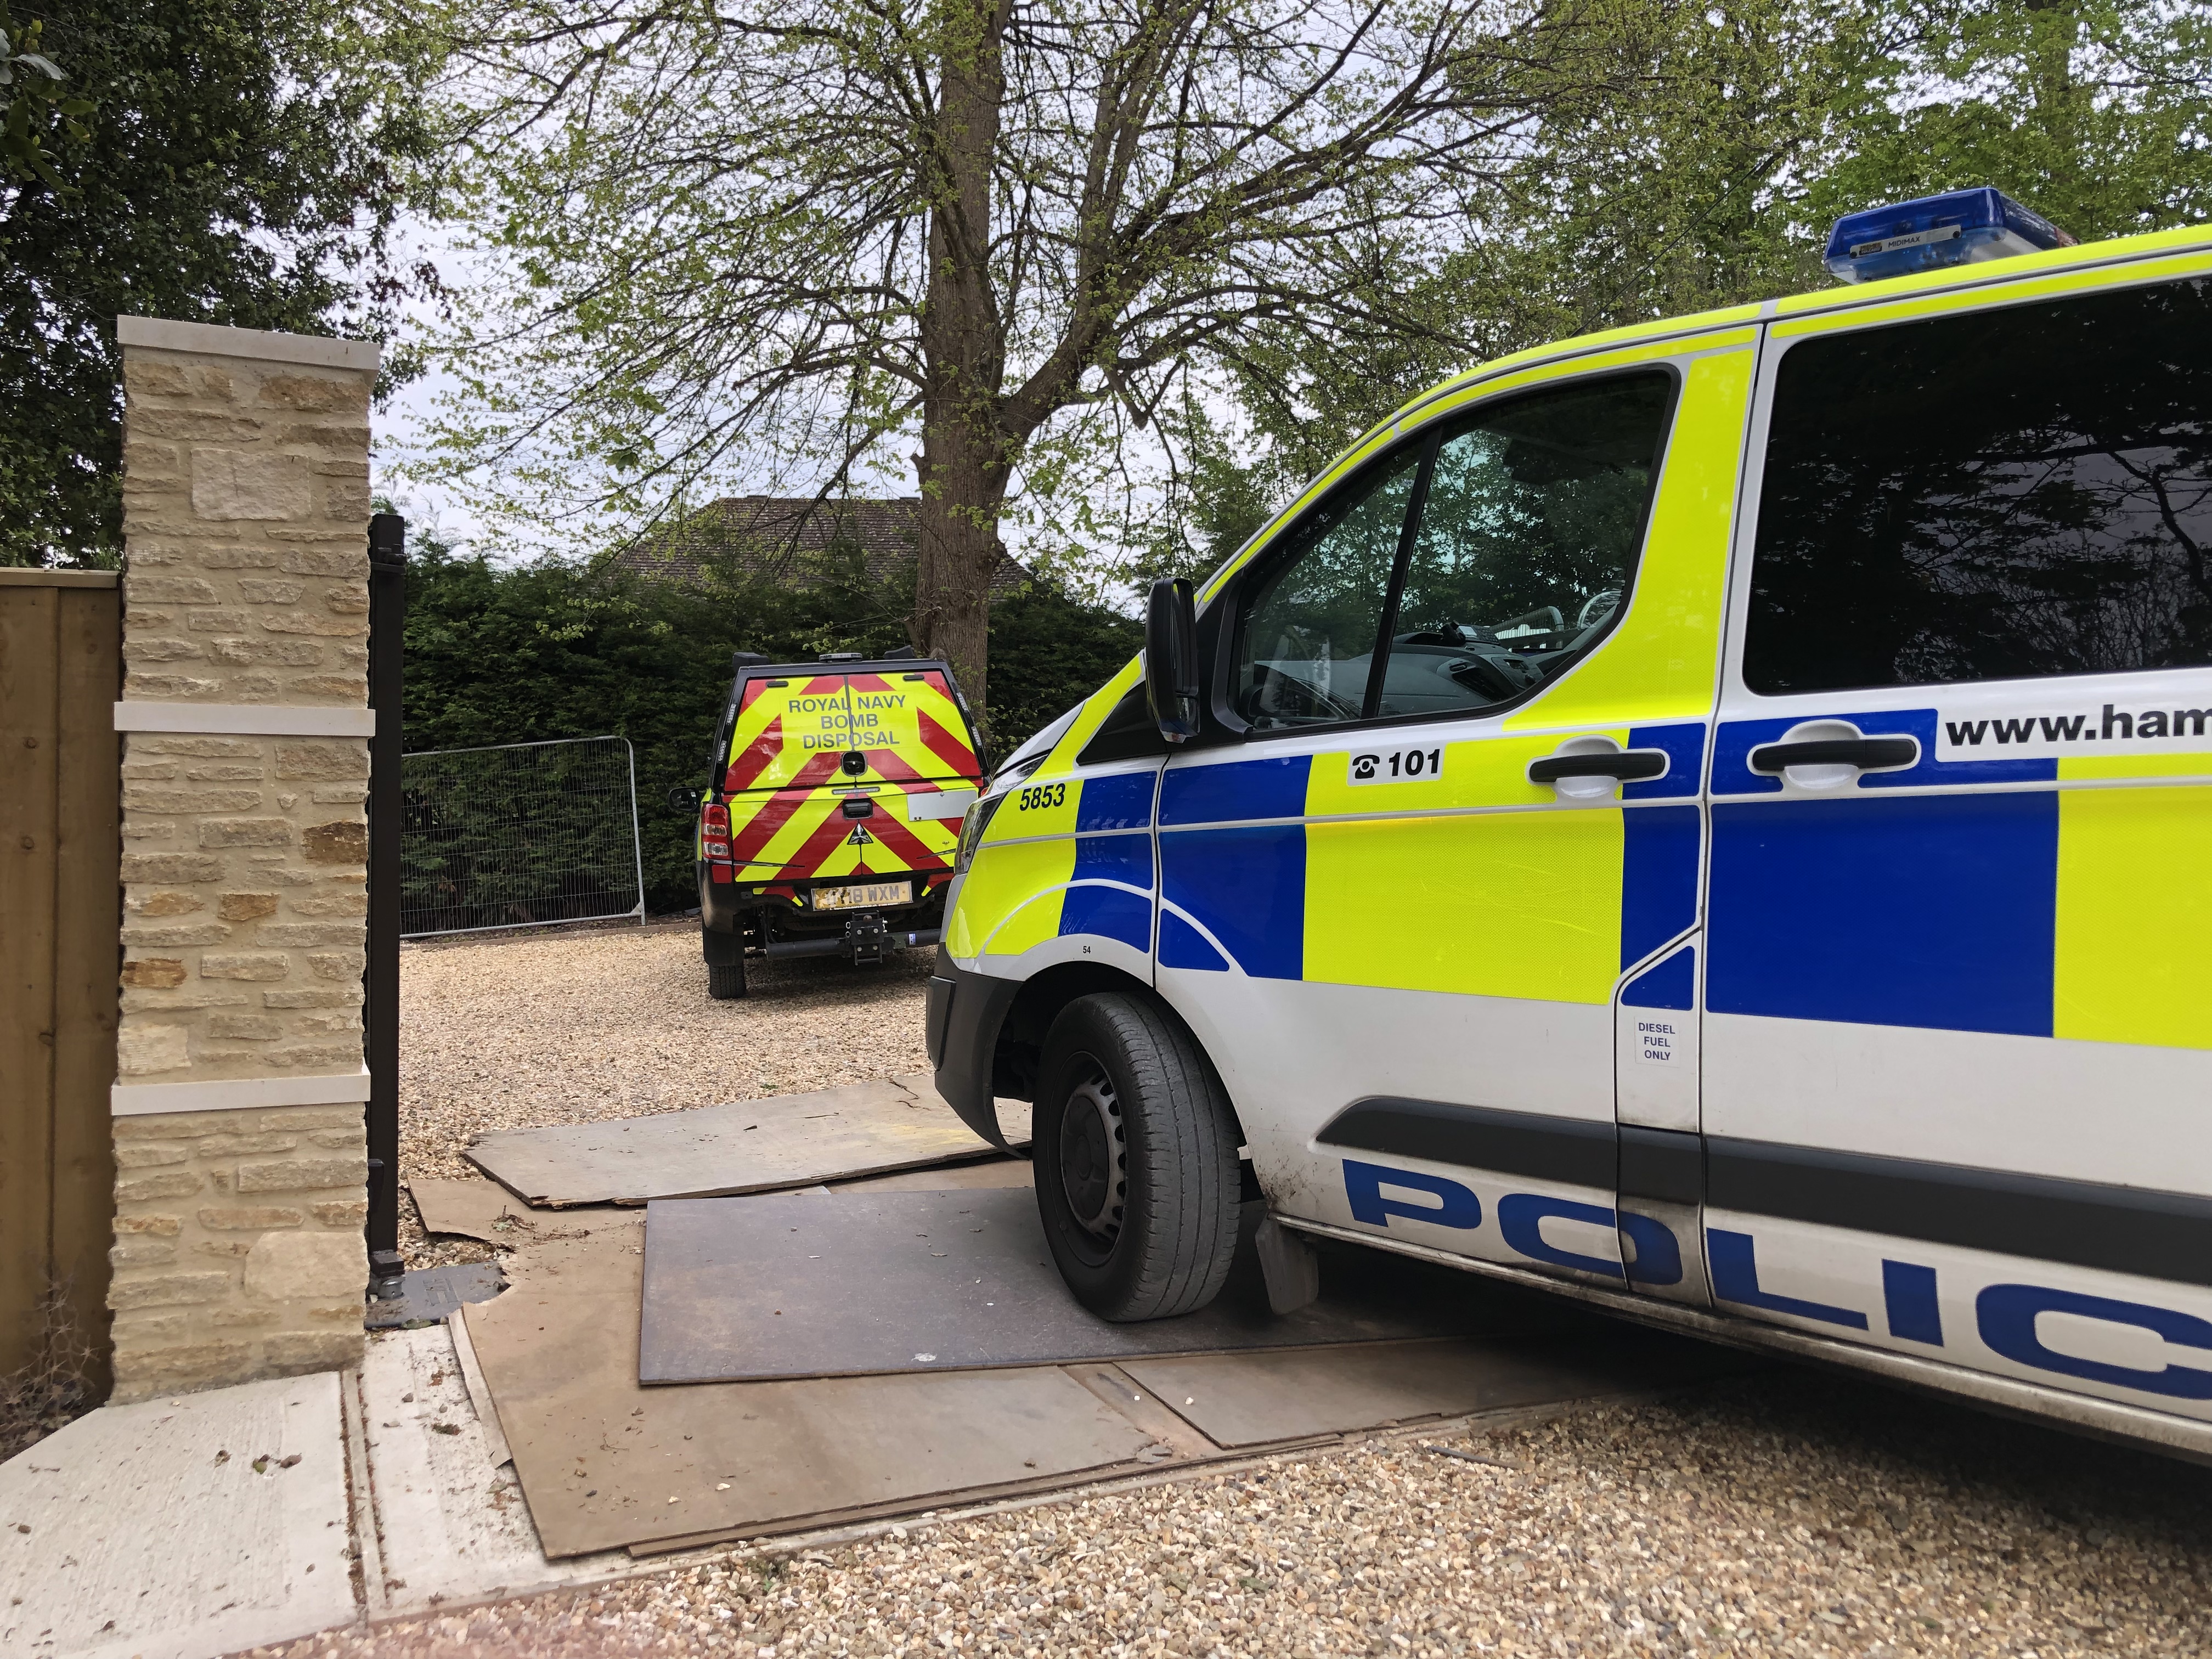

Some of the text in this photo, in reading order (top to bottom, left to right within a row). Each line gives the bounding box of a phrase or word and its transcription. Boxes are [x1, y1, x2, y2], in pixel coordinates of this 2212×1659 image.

[1888, 236, 1920, 247] MIDIMAX
[789, 695, 906, 713] ROYAL NAVY
[821, 714, 878, 730] BOMB
[803, 731, 900, 749] DISPOSAL
[1389, 749, 1440, 777] 101
[1019, 783, 1065, 811] 5853
[867, 885, 899, 901] WXM
[1082, 945, 1091, 954] 54
[1638, 1022, 1675, 1034] DIESEL
[1644, 1036, 1671, 1047] FUEL
[1644, 1049, 1671, 1060] ONLY
